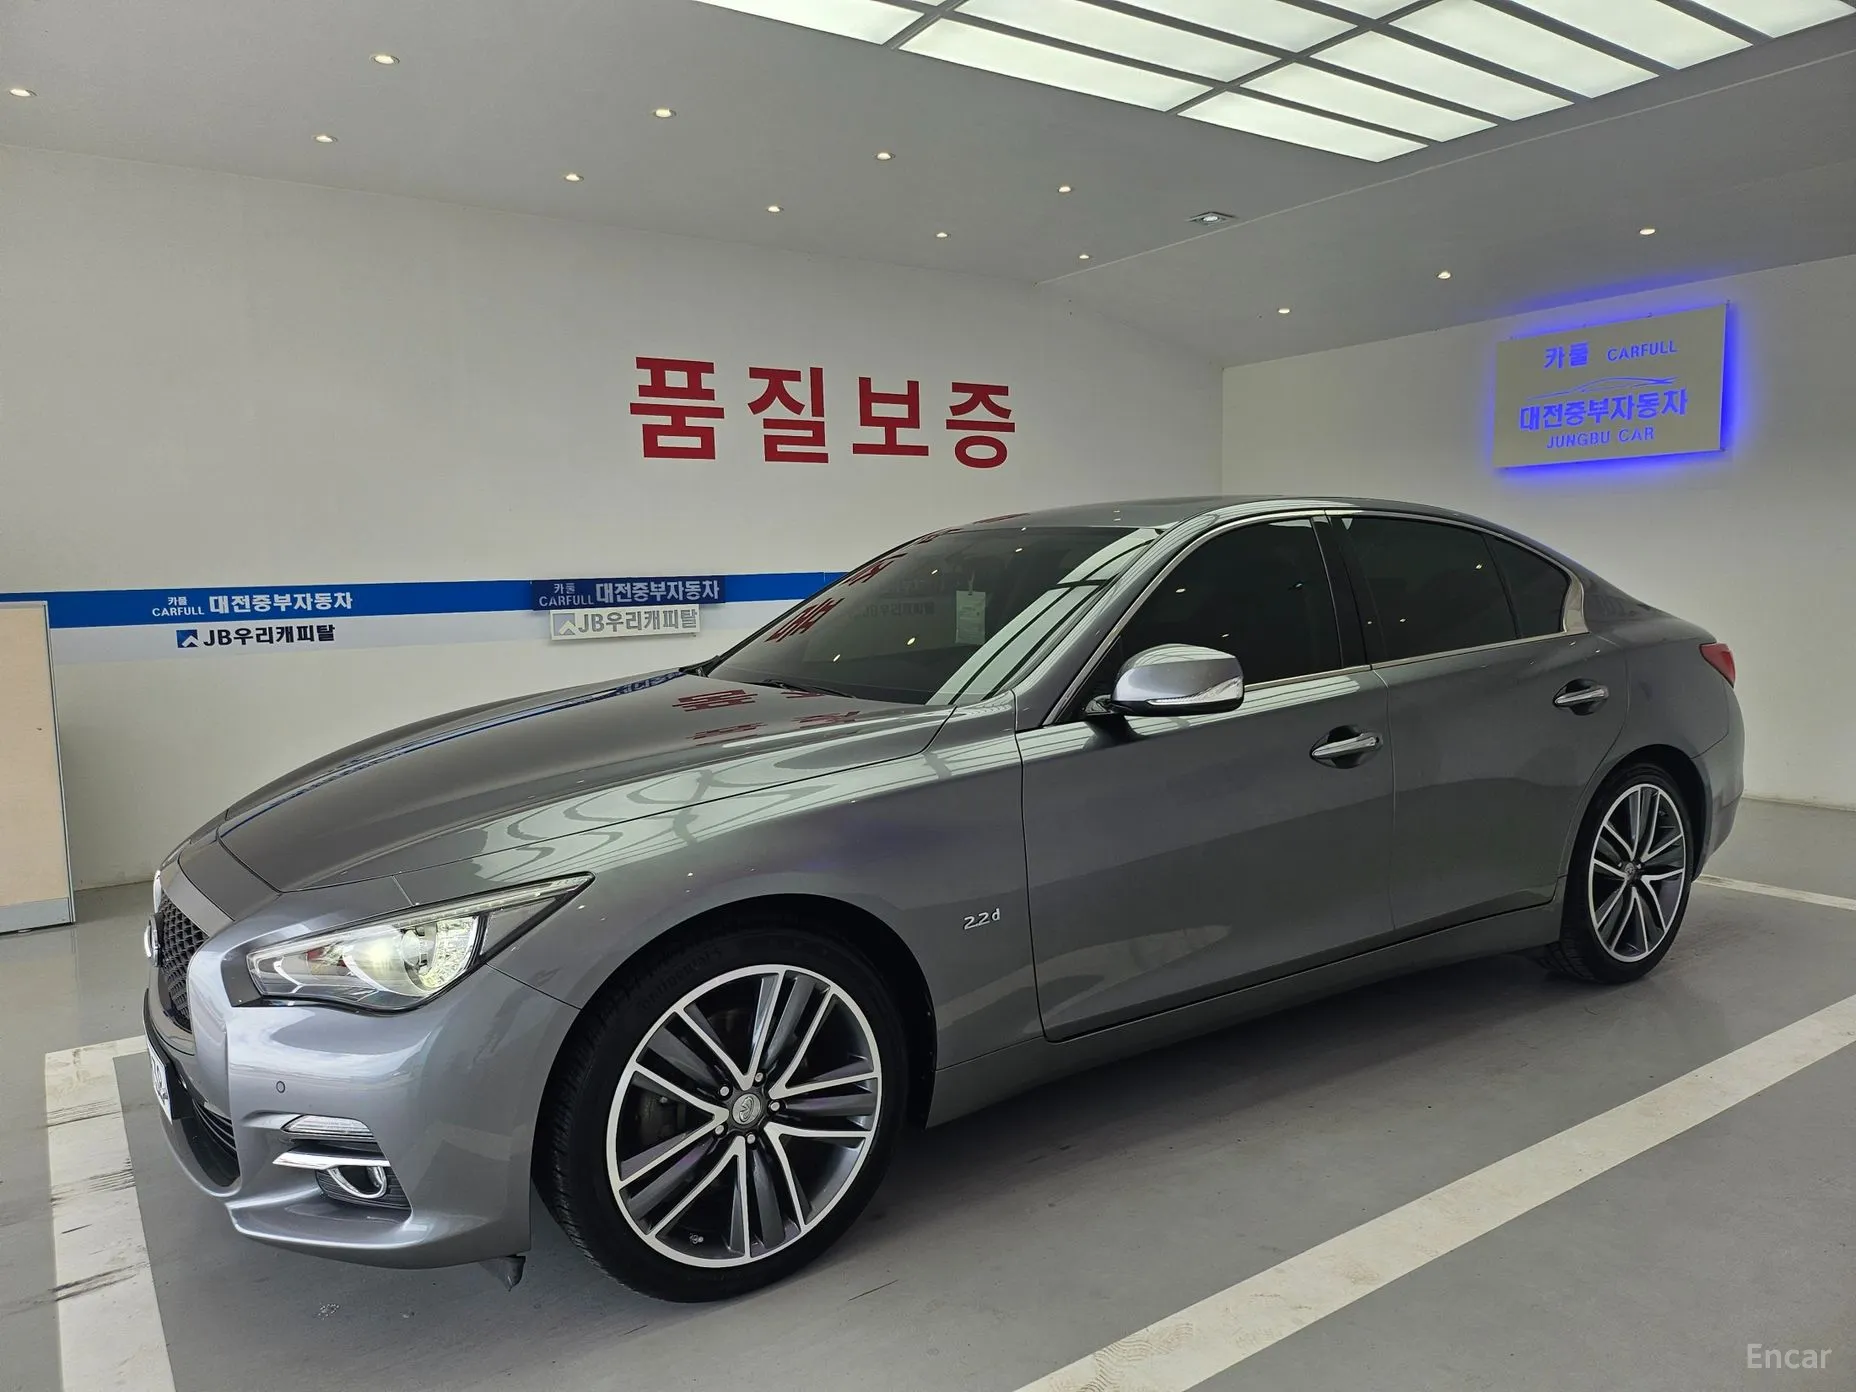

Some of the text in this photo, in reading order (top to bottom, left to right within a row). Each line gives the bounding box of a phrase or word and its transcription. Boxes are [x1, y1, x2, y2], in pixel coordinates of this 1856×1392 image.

[1607, 340, 1677, 362] CARFULL
[629, 356, 1016, 469] 품질보증
[1547, 427, 1656, 449] JUNGBU CAR
[209, 592, 353, 614] 대전중부자동차
[538, 595, 594, 608] CARFULL
[595, 579, 720, 605] 대전중부자동차
[152, 606, 205, 617] CARFULL
[578, 608, 698, 634] JB우리캐피탈
[203, 624, 336, 647] JB우리캐피탈
